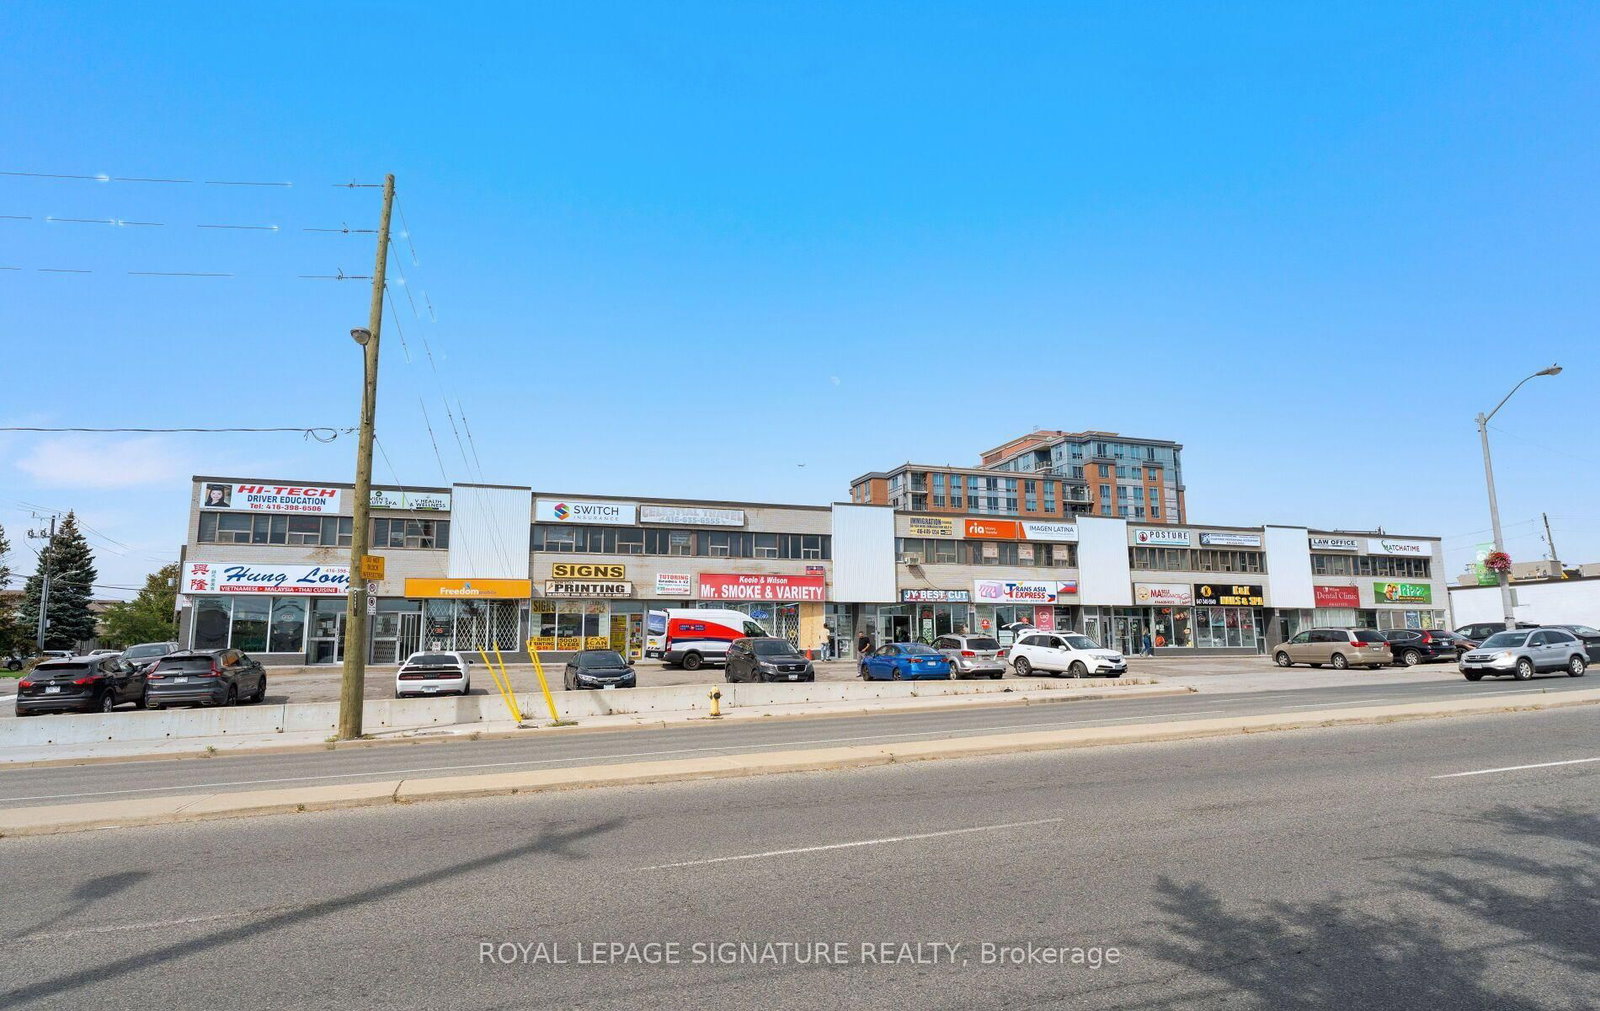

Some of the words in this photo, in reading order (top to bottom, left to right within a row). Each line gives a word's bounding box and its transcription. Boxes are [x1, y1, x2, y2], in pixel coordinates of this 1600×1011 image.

[237, 485, 338, 498] HI-TECH
[247, 495, 278, 504] DRIVER
[279, 496, 327, 506] EDUCATION
[573, 505, 620, 516] SWITCH
[969, 522, 985, 534] ria
[1149, 531, 1189, 540] POSTURE
[224, 566, 289, 587] Hung
[554, 565, 623, 577] SIGNS
[740, 576, 759, 584] Keele
[440, 586, 480, 596] Freedom
[554, 584, 626, 593] PRINTING
[701, 584, 718, 598] Mr.
[721, 584, 760, 599] SMOKE
[765, 586, 773, 599] &
[776, 586, 823, 599] VARIETY
[920, 590, 945, 599] BEST
[948, 590, 969, 599] CUT
[1015, 591, 1046, 599] EXPRESS
[1317, 591, 1338, 600] Dental
[1338, 591, 1358, 600] Clinic
[533, 600, 557, 612] SIGNS
